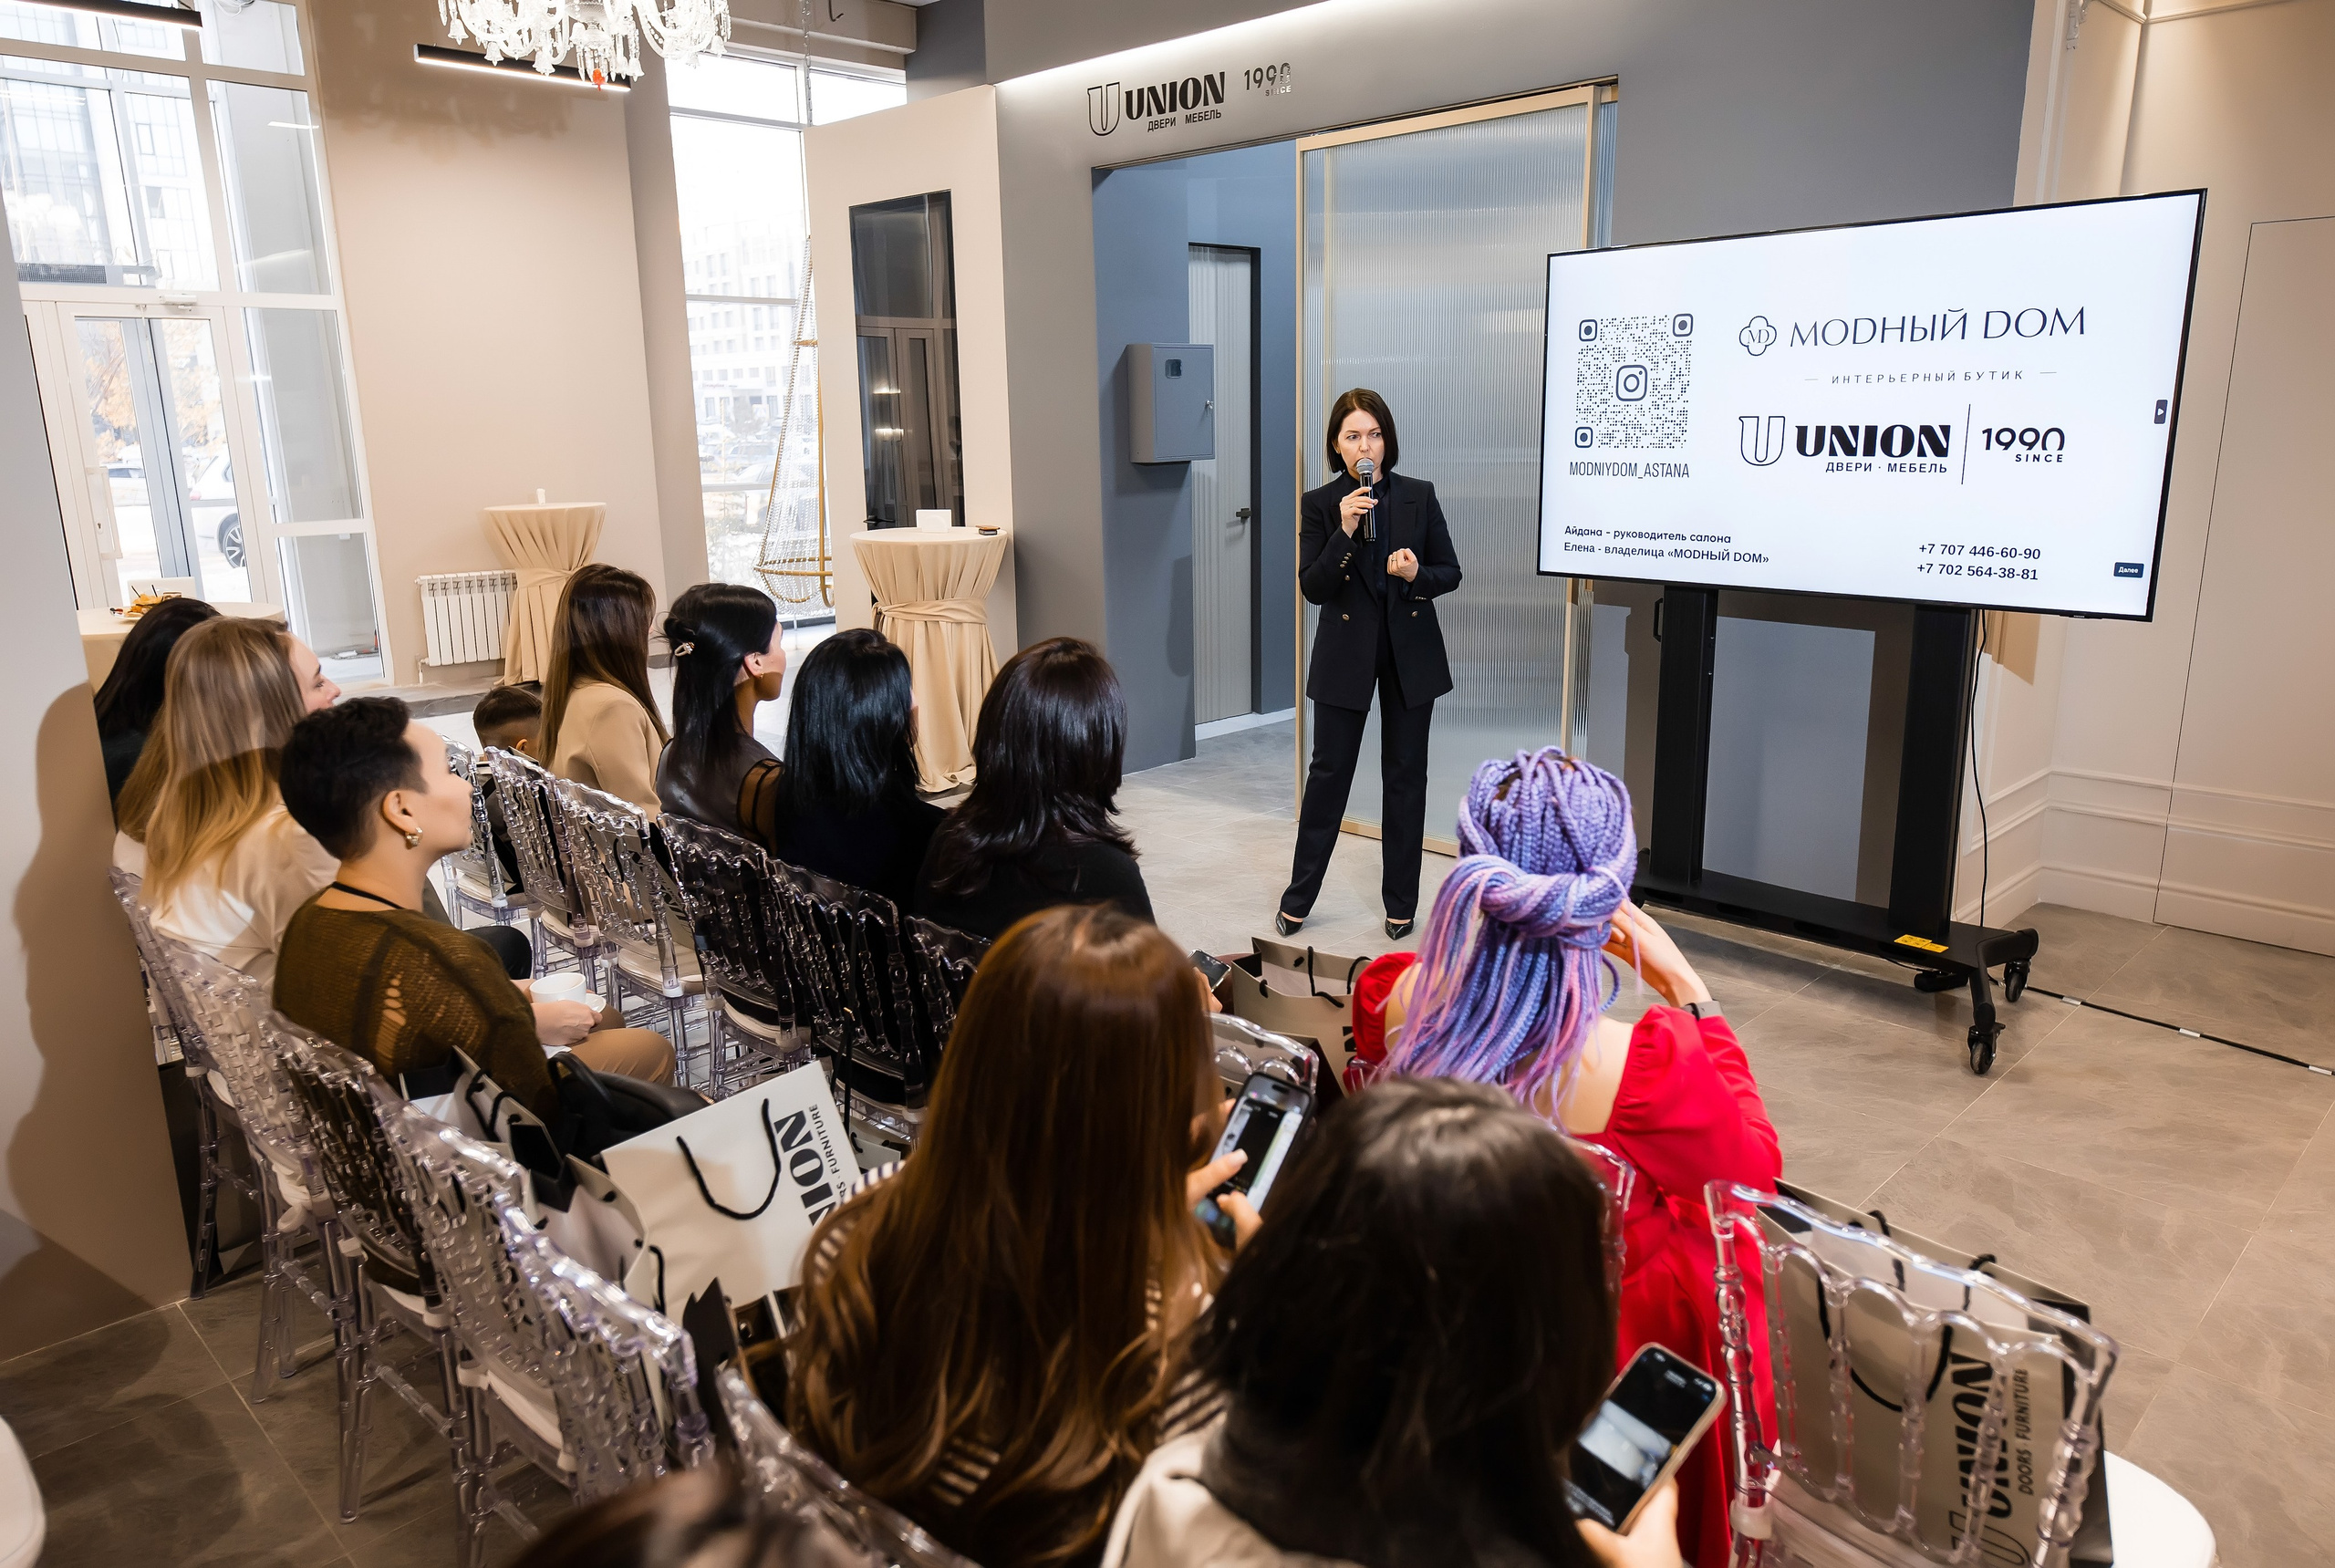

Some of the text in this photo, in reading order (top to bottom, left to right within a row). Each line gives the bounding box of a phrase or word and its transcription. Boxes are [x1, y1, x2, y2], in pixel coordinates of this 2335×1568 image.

[1125, 71, 1226, 120] UNION
[1147, 108, 1223, 133] ДВЕРИ МЕБЕЛЬ
[1983, 306, 2085, 339] DOM
[1832, 370, 2022, 384] ИНТЕРЬЕРНЫЙ БУТИК
[1794, 424, 1951, 459] UNION
[1981, 427, 2066, 452] 1990
[1825, 462, 1947, 473] ДВЕРИ МЕБЕЛЬ
[2015, 453, 2063, 463] SINCE
[1569, 461, 1690, 480] MODNIYDOM_ASTANA
[1564, 525, 1603, 537] Айдана
[1613, 530, 1687, 542] руководитель
[1689, 534, 1731, 544] салона
[1563, 542, 1595, 554] Елена
[1604, 545, 1665, 559] владелица
[1733, 552, 1769, 564] DOM»
[1918, 543, 2041, 560] +7 707 446-60-90
[1916, 563, 2039, 581] +7 702 564-38-81
[809, 1104, 840, 1175] FURNITURE
[773, 1110, 836, 1227] ION
[2013, 1369, 2034, 1496] DOORS FURNITURE
